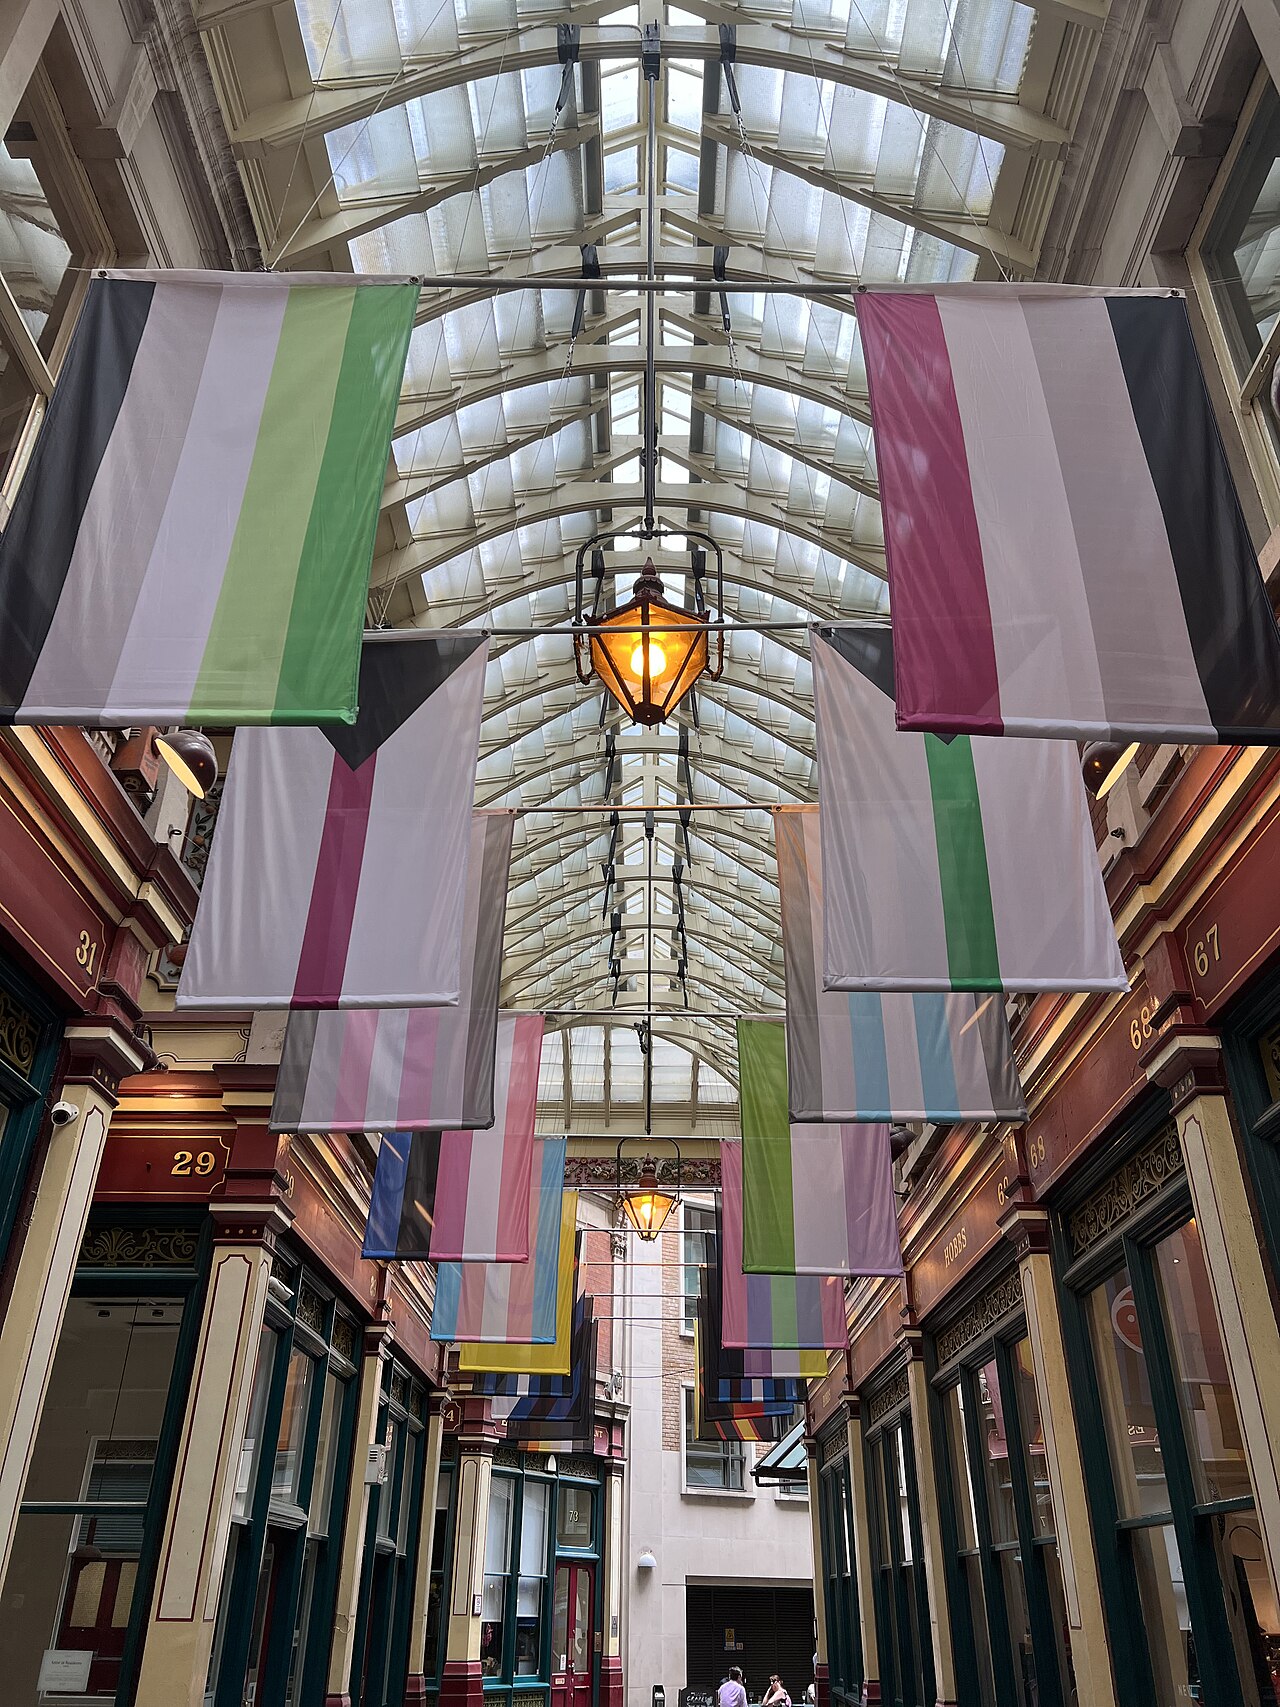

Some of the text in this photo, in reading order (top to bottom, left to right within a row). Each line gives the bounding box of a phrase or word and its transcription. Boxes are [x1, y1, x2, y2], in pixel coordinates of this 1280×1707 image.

[75, 929, 97, 976] 31
[1193, 923, 1221, 977] 67
[170, 1151, 216, 1176] 29
[1030, 1135, 1045, 1169] 68
[943, 1227, 967, 1268] HOBBS
[569, 1510, 579, 1522] 73
